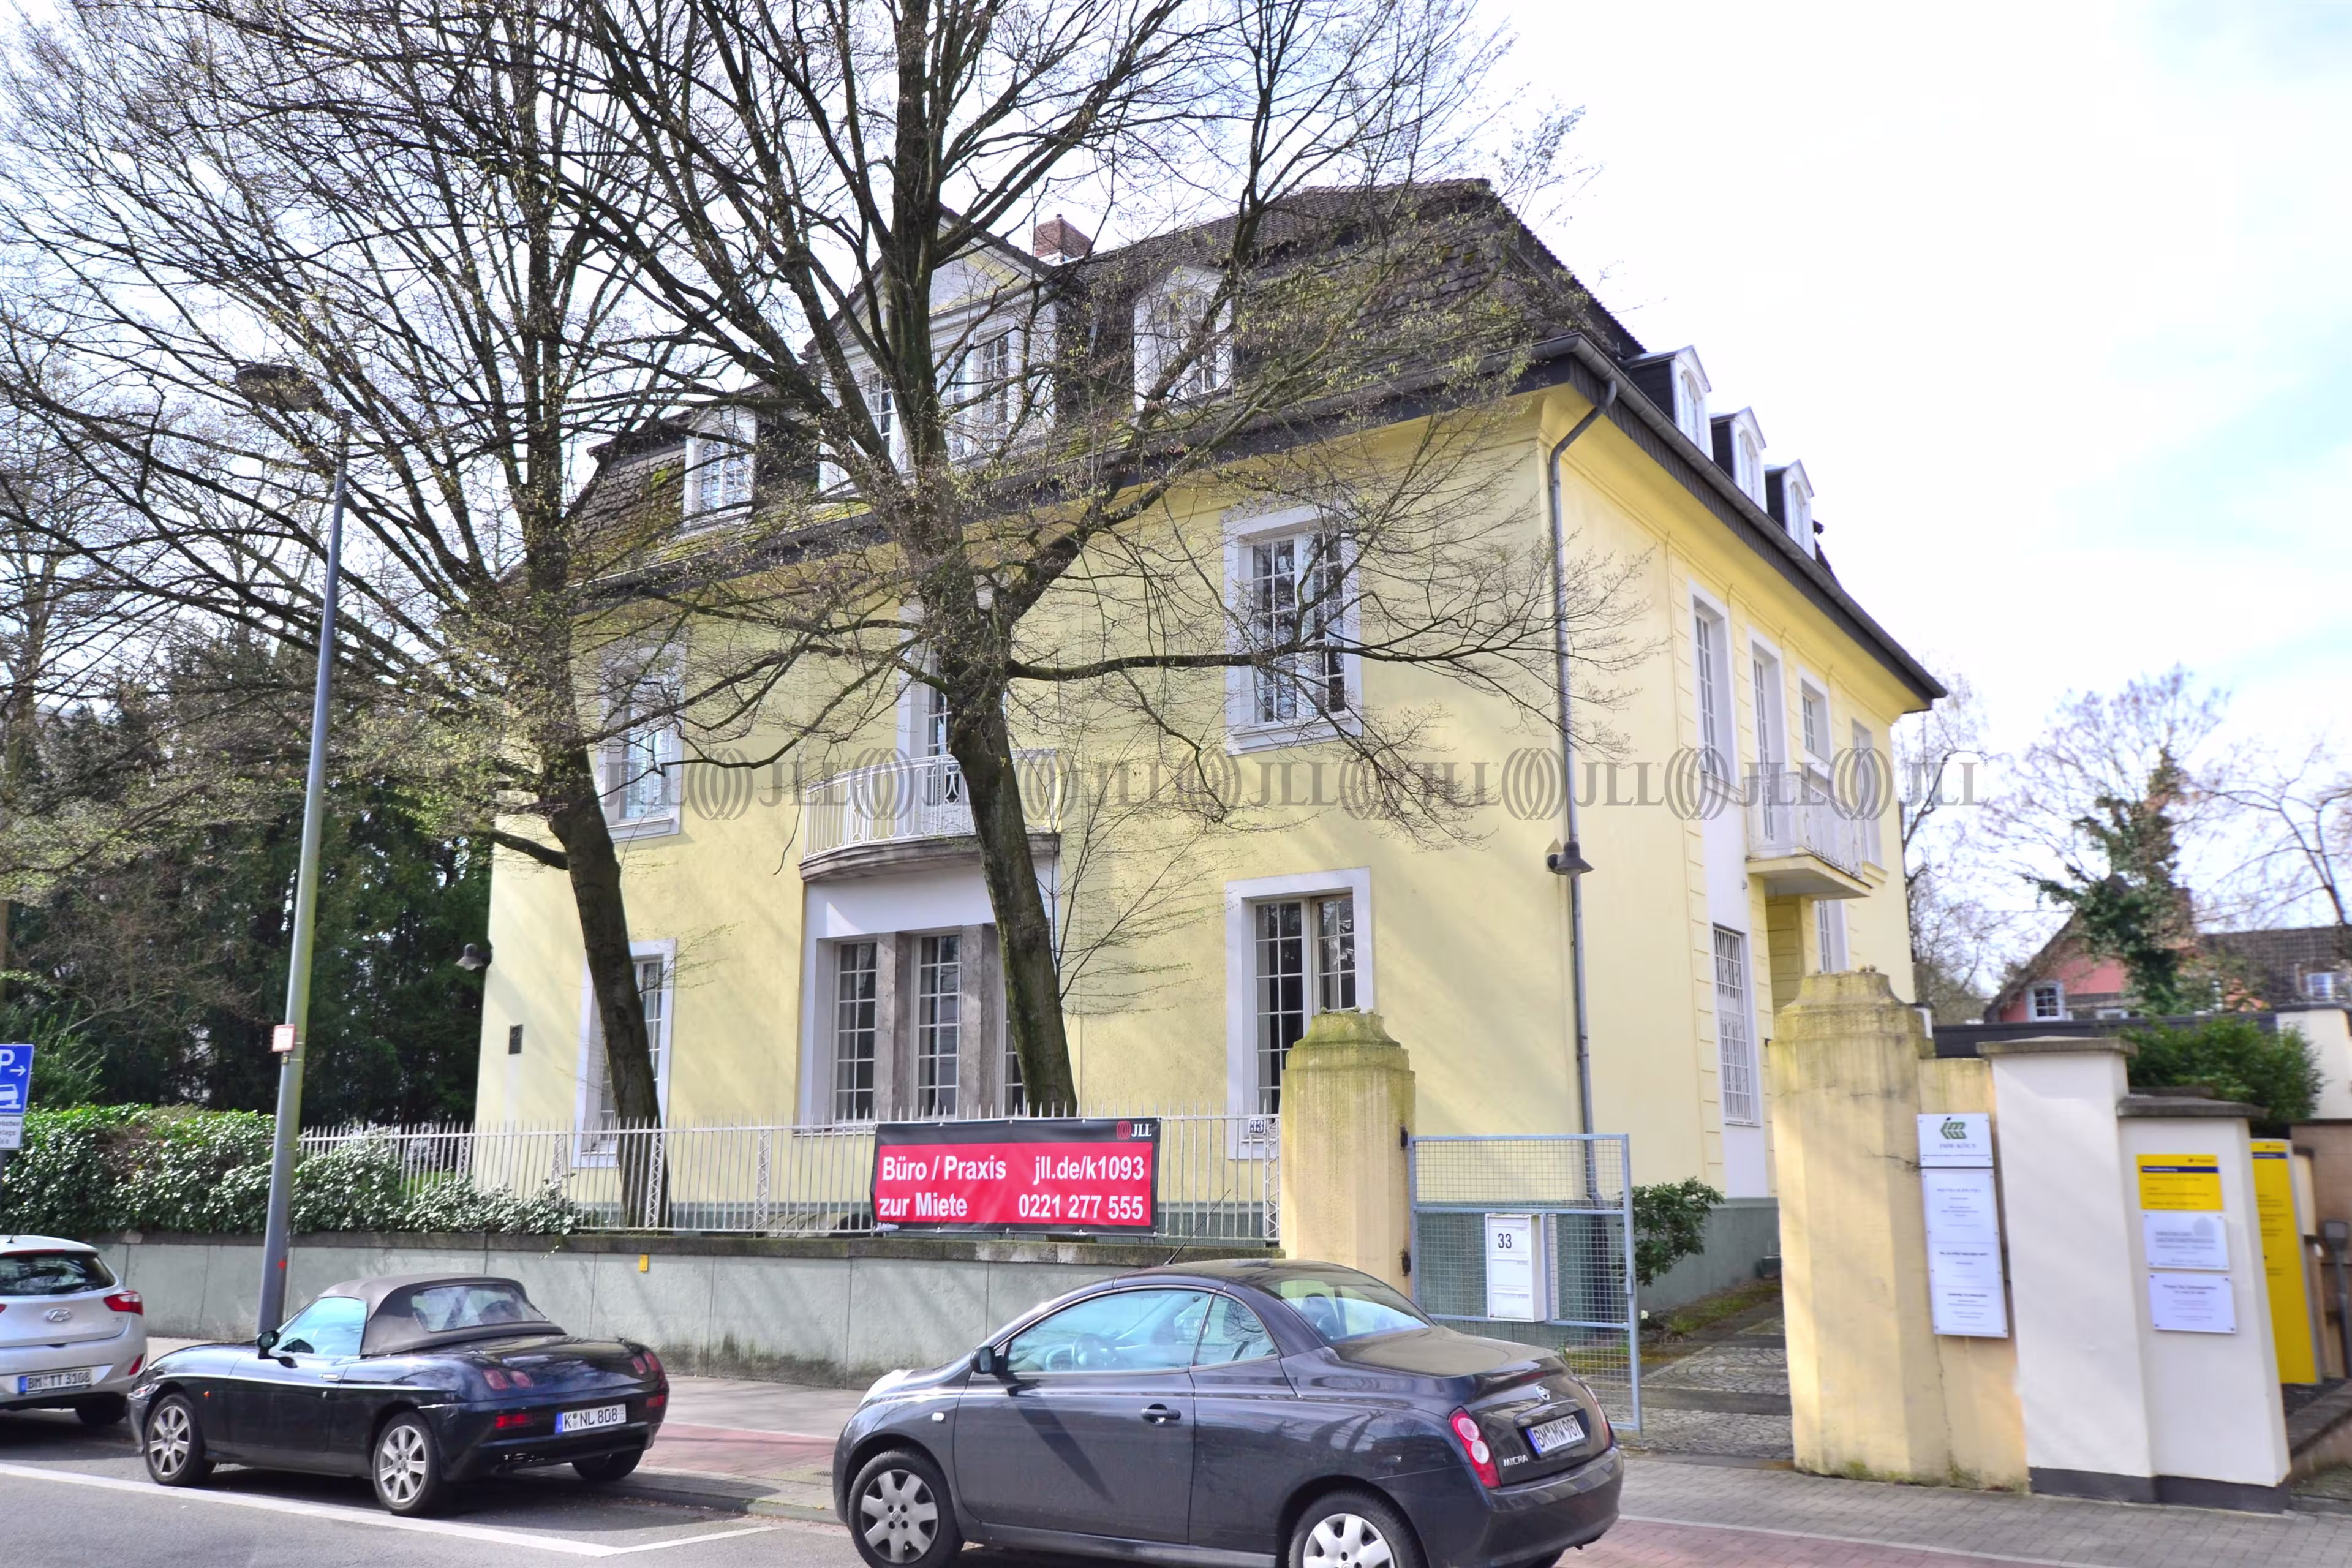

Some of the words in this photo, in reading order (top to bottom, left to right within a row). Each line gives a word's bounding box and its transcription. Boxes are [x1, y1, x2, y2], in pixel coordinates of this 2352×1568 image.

[1131, 1123, 1152, 1137] JLL
[883, 1156, 927, 1180] Büro
[932, 1155, 940, 1180] /
[944, 1155, 1007, 1180] Praxis
[1033, 1156, 1144, 1185] jll.de/k1093
[879, 1197, 910, 1216] zur
[915, 1192, 968, 1217] Miete
[1019, 1194, 1060, 1218] 0221
[1068, 1195, 1102, 1218] 277
[1108, 1196, 1144, 1219] 555
[1498, 1233, 1512, 1249] 33
[50, 1374, 63, 1386] TT
[564, 1414, 572, 1429] K
[580, 1412, 595, 1427] NL
[598, 1408, 618, 1424] 808
[1562, 1417, 1581, 1438] 987
[1503, 1454, 1529, 1467] MICRA
